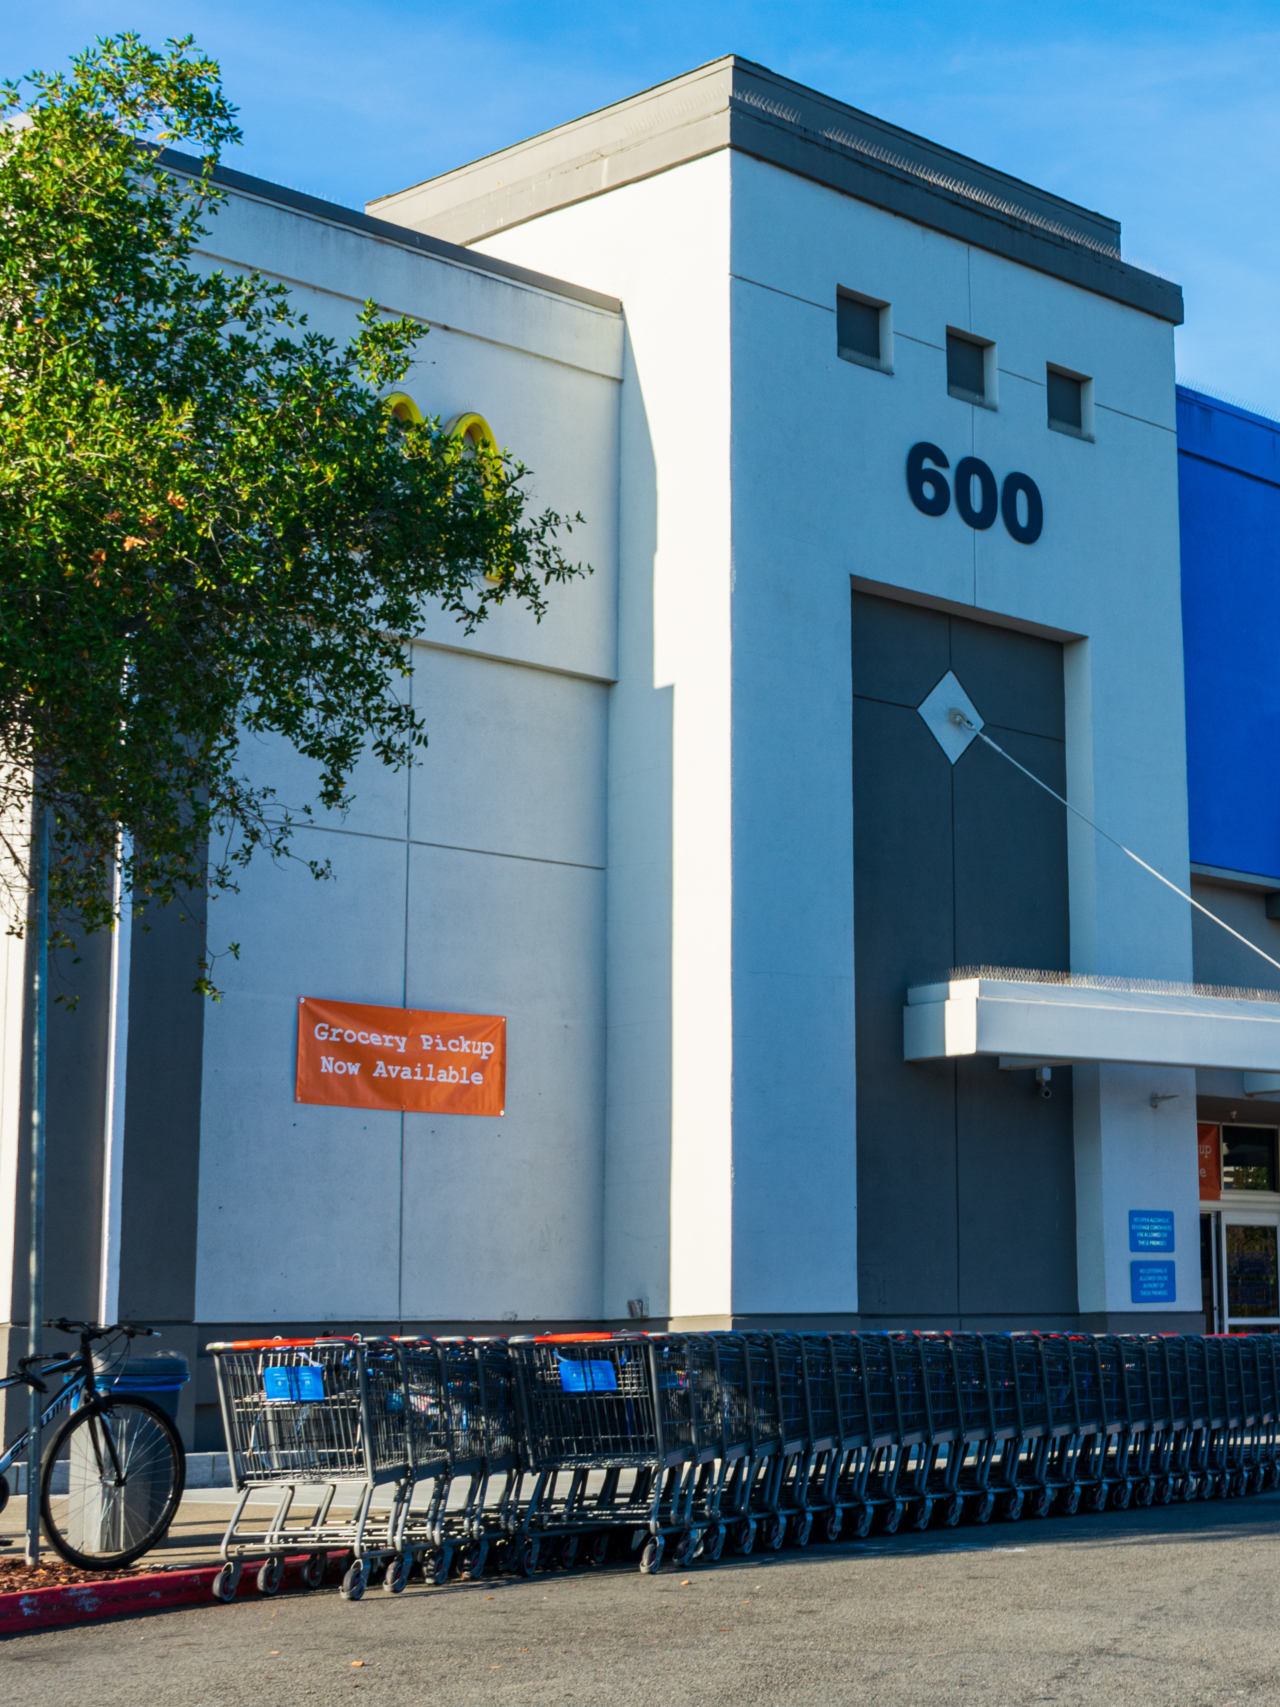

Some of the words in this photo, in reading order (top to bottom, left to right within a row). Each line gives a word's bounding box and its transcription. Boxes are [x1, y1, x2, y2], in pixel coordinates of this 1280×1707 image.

[906, 441, 1044, 545] 600
[314, 1023, 407, 1052] Grocery
[420, 1034, 495, 1060] Pickup
[320, 1056, 361, 1076] Now
[372, 1061, 484, 1085] Available
[10, 1384, 80, 1460] SCWINN
